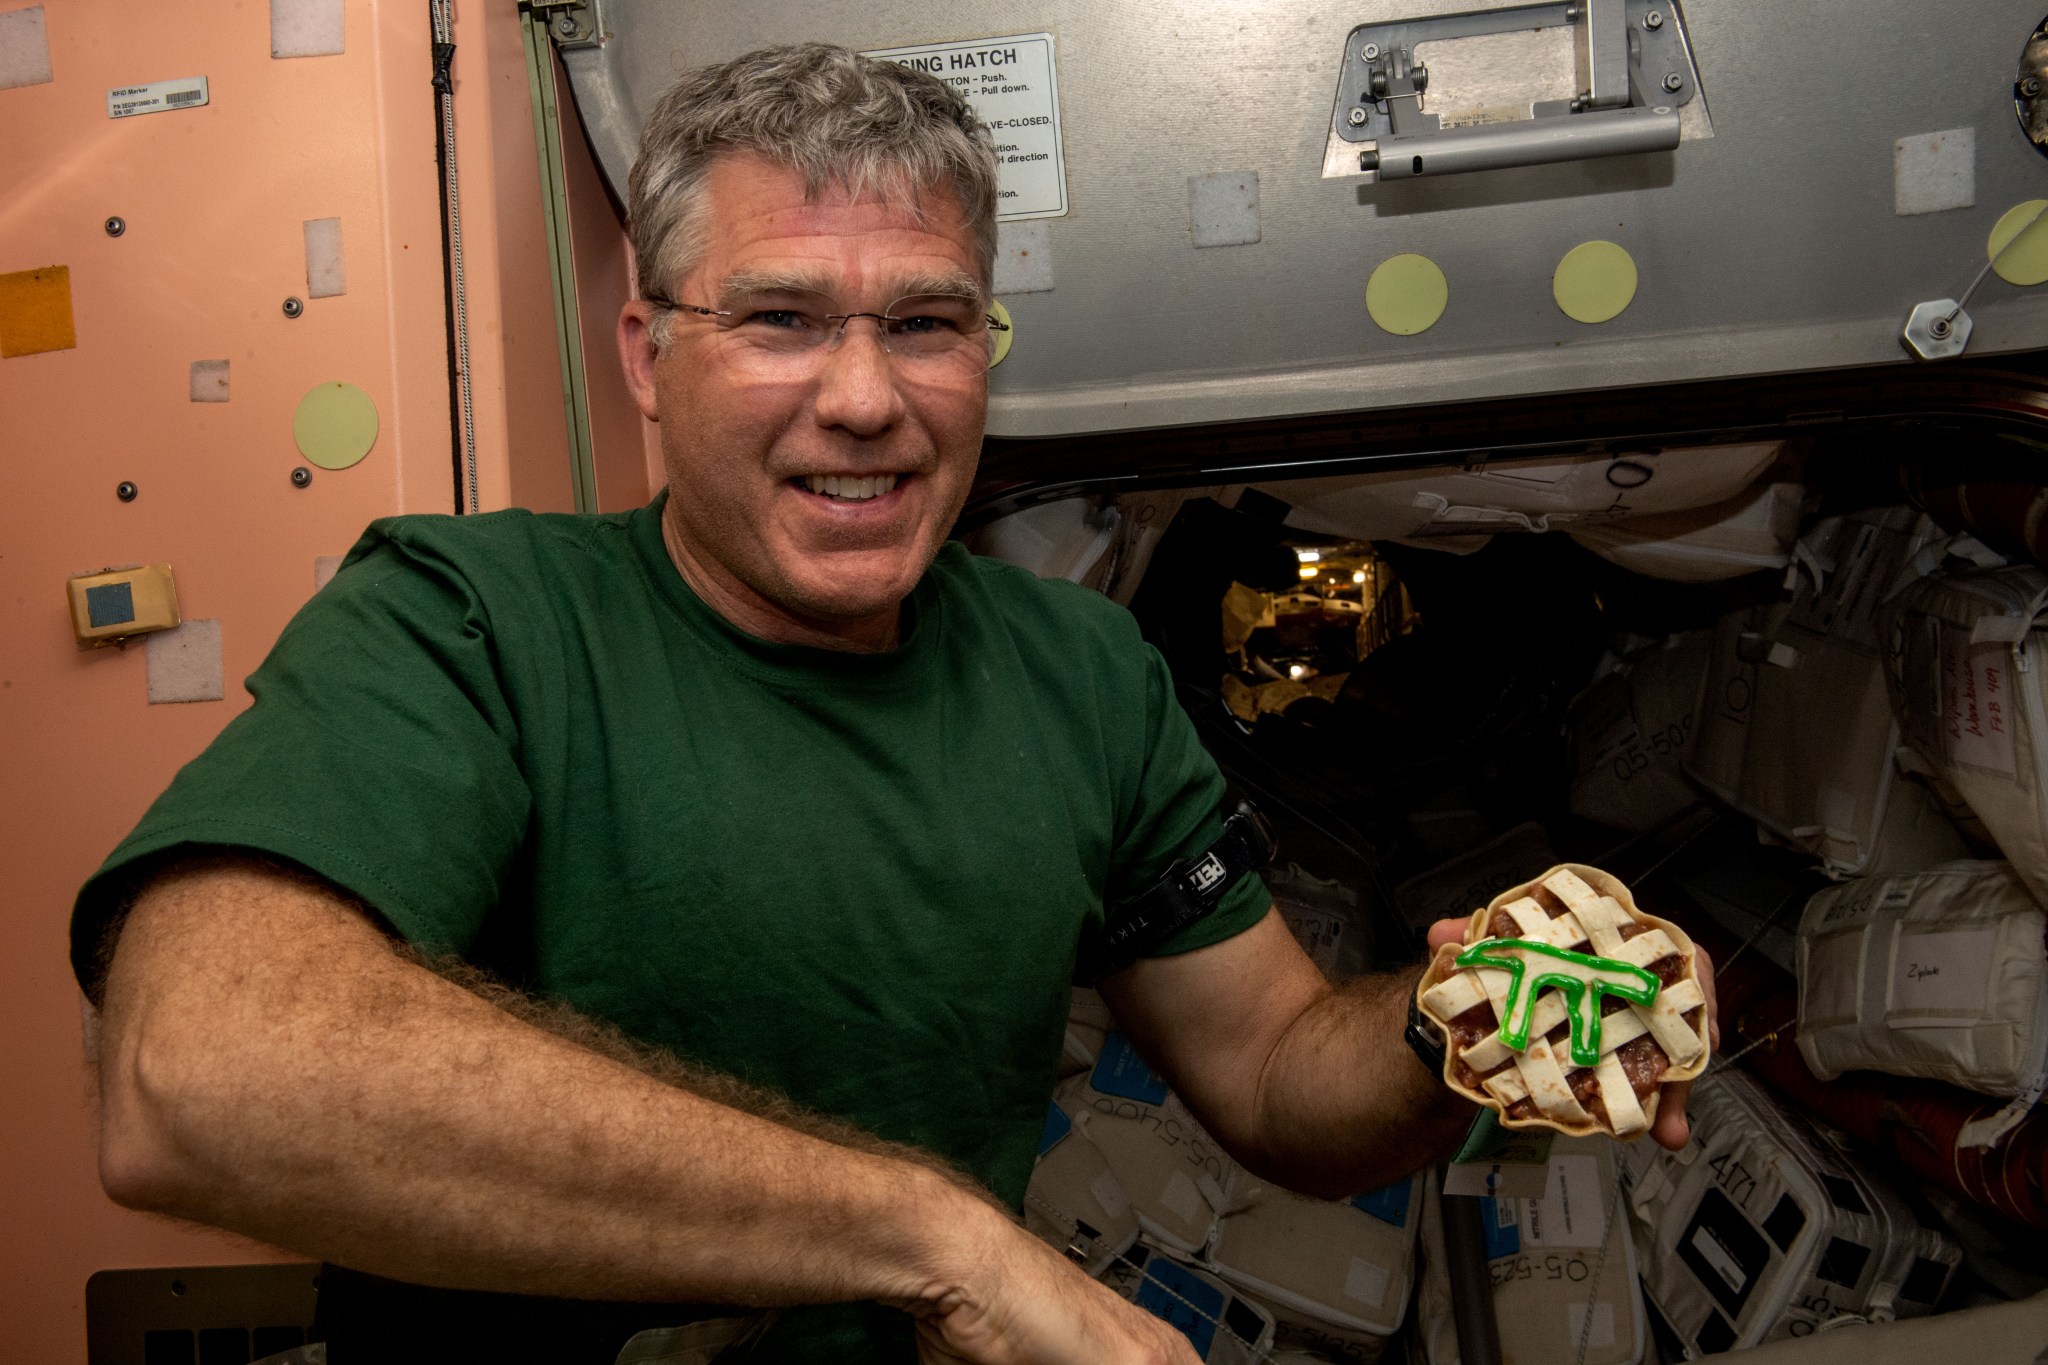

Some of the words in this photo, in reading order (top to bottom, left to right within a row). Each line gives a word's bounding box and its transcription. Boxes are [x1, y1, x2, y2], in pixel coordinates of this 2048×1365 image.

[950, 48, 1017, 70] HATCH
[981, 73, 1007, 83] Push.
[112, 89, 127, 97] RFID
[127, 87, 148, 95] Marker
[981, 86, 998, 95] Pull
[1001, 83, 1030, 94] down.
[1007, 152, 1049, 163] direction
